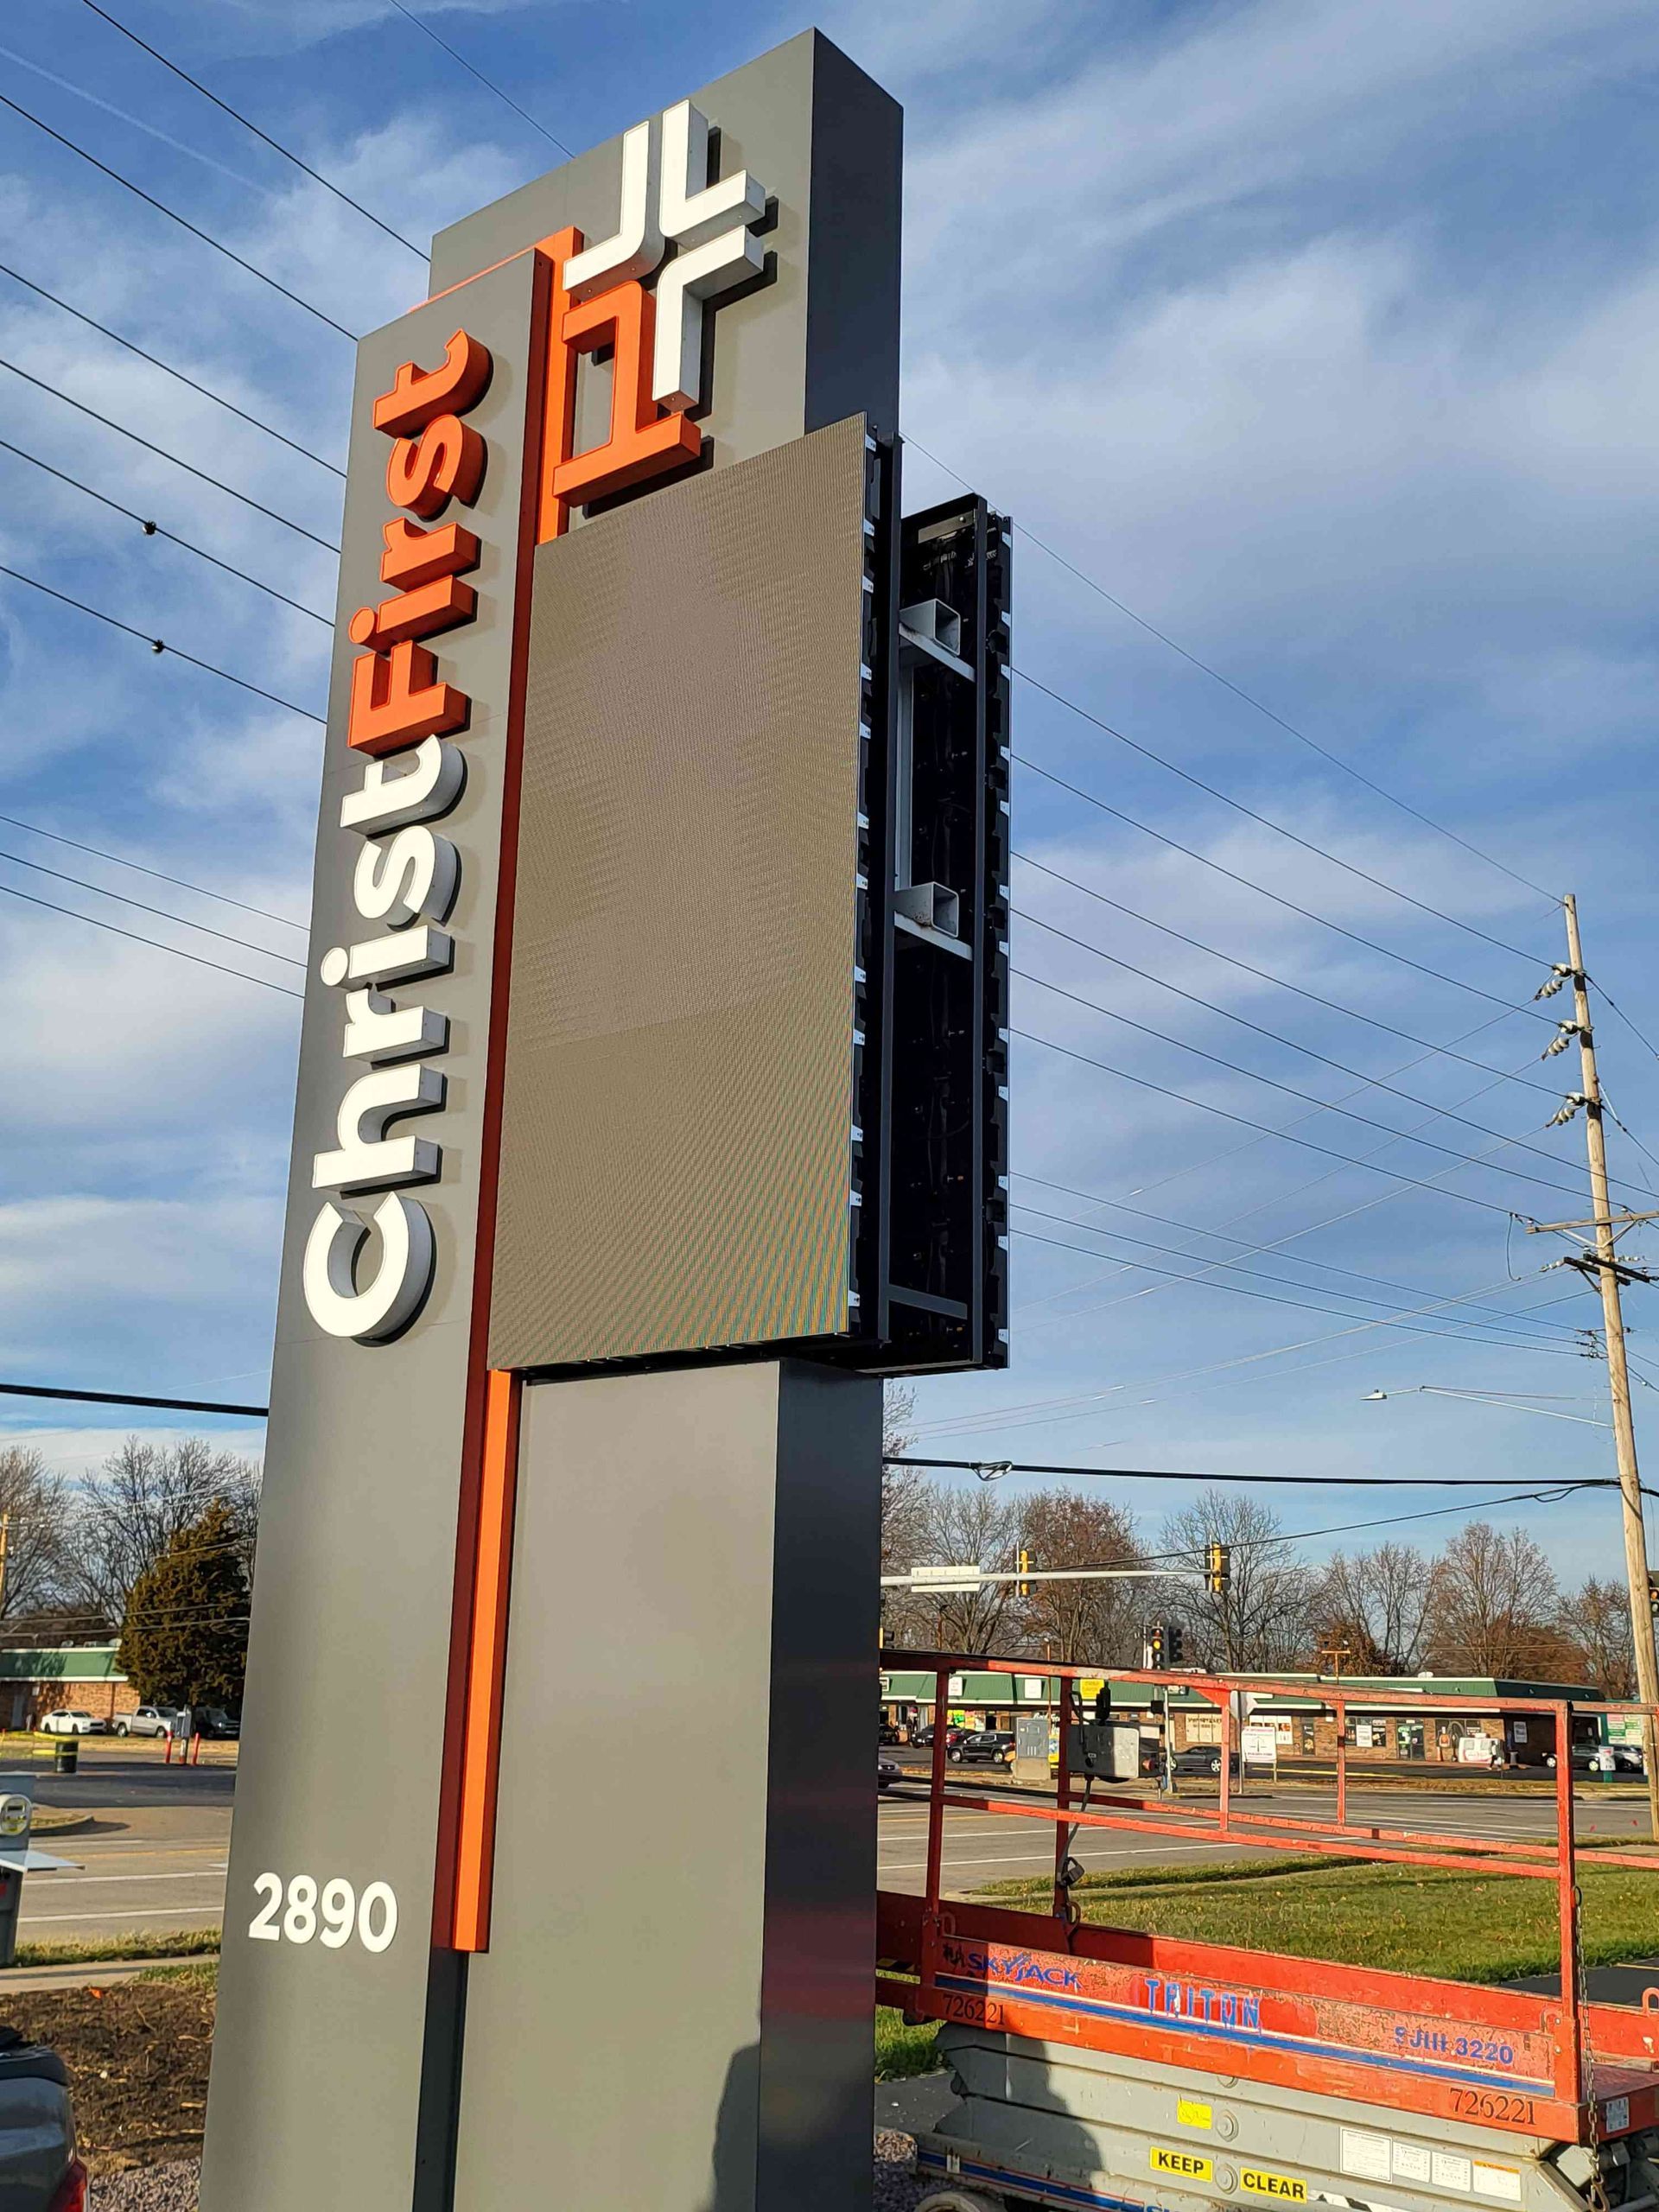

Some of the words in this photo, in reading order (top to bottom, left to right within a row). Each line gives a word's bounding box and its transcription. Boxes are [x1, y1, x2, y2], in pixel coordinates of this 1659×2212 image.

[248, 1872, 398, 1953] 2890
[968, 1952, 1083, 1989] SKYJACK
[944, 1994, 1005, 2025] 726221
[1145, 1979, 1259, 2031] TRITON
[1455, 2037, 1514, 2065] 3220
[1450, 2088, 1536, 2126] 726221
[1158, 2152, 1205, 2175] KEEP
[1243, 2172, 1305, 2200] CLEAR
